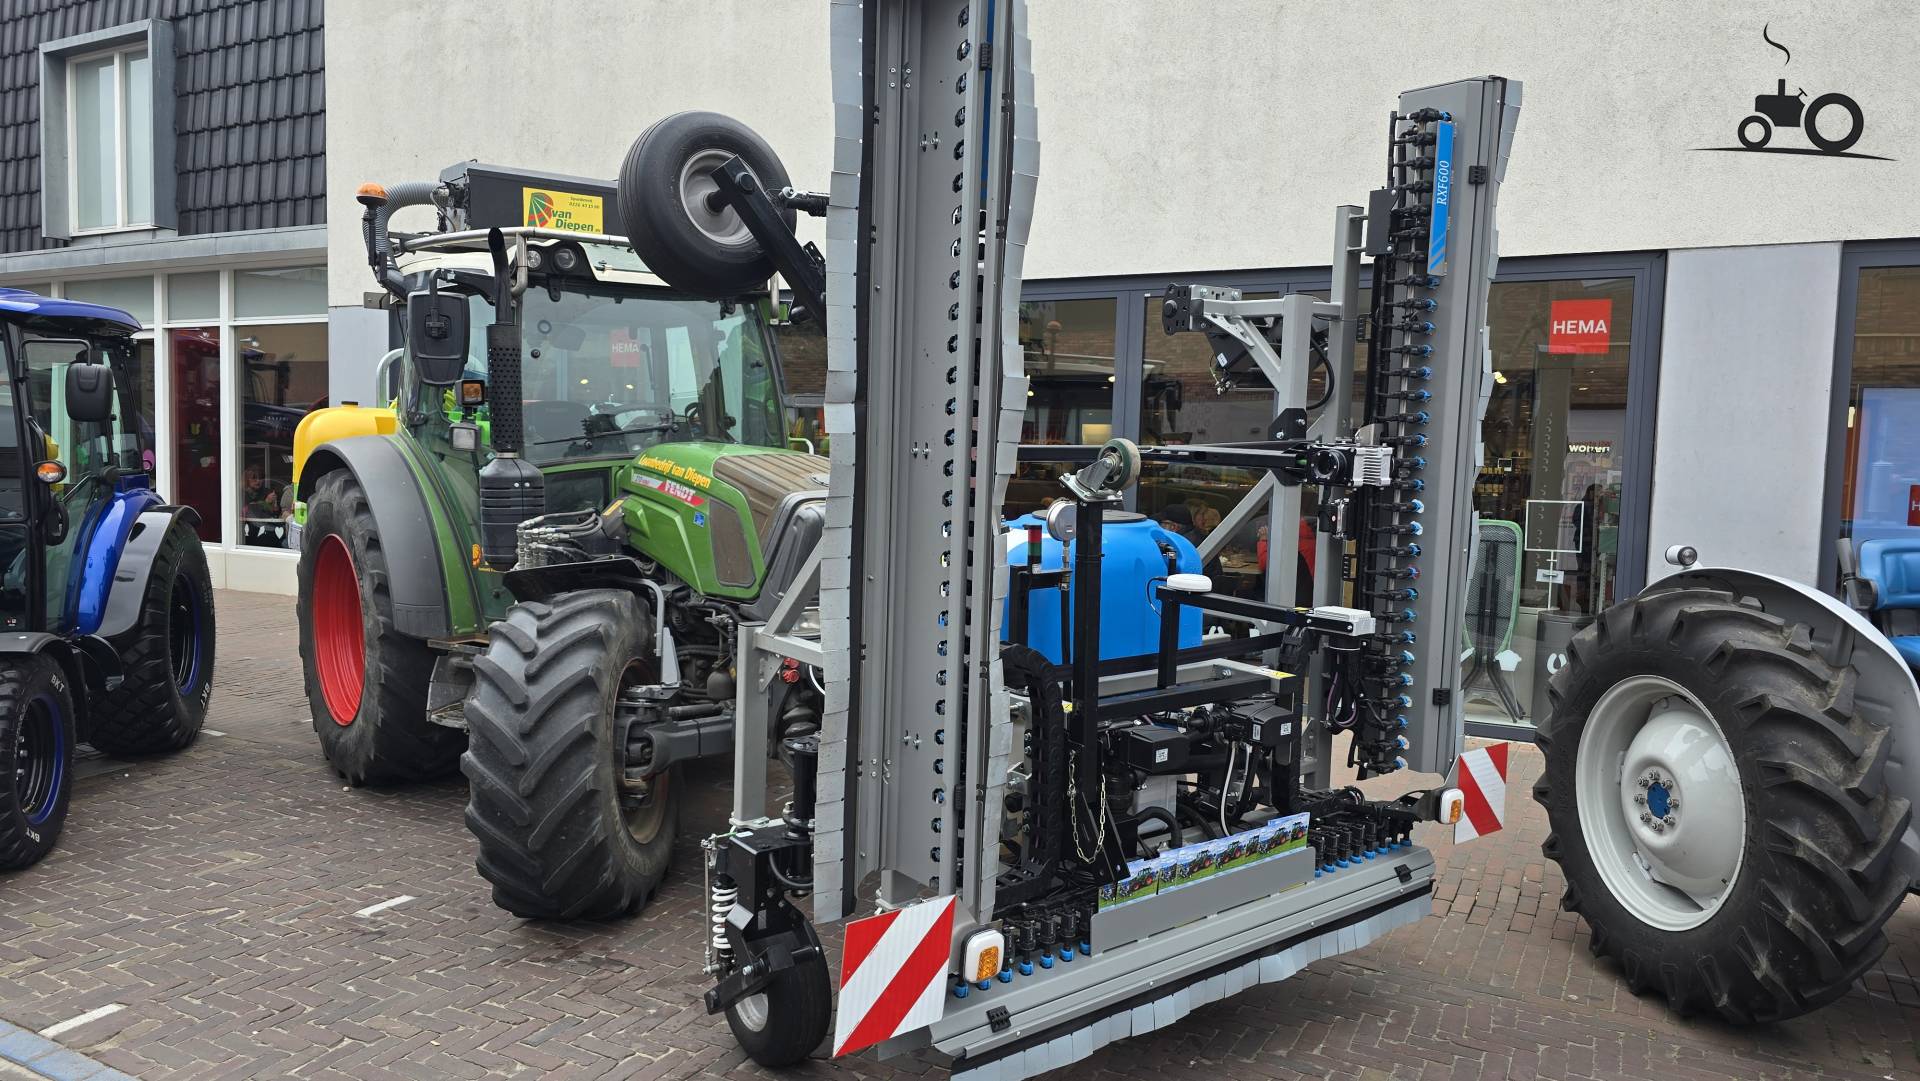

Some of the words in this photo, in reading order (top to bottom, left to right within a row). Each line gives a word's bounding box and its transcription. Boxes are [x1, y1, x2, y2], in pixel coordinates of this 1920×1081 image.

[1436, 160, 1449, 206] RXF600
[552, 209, 572, 219] van
[555, 218, 594, 232] Diepen
[1553, 319, 1608, 335] HEMA
[611, 343, 640, 353] HEMA
[684, 466, 712, 489] Diepen
[665, 479, 697, 502] FENDT
[50, 674, 65, 692] BKT
[200, 681, 210, 710] BKT
